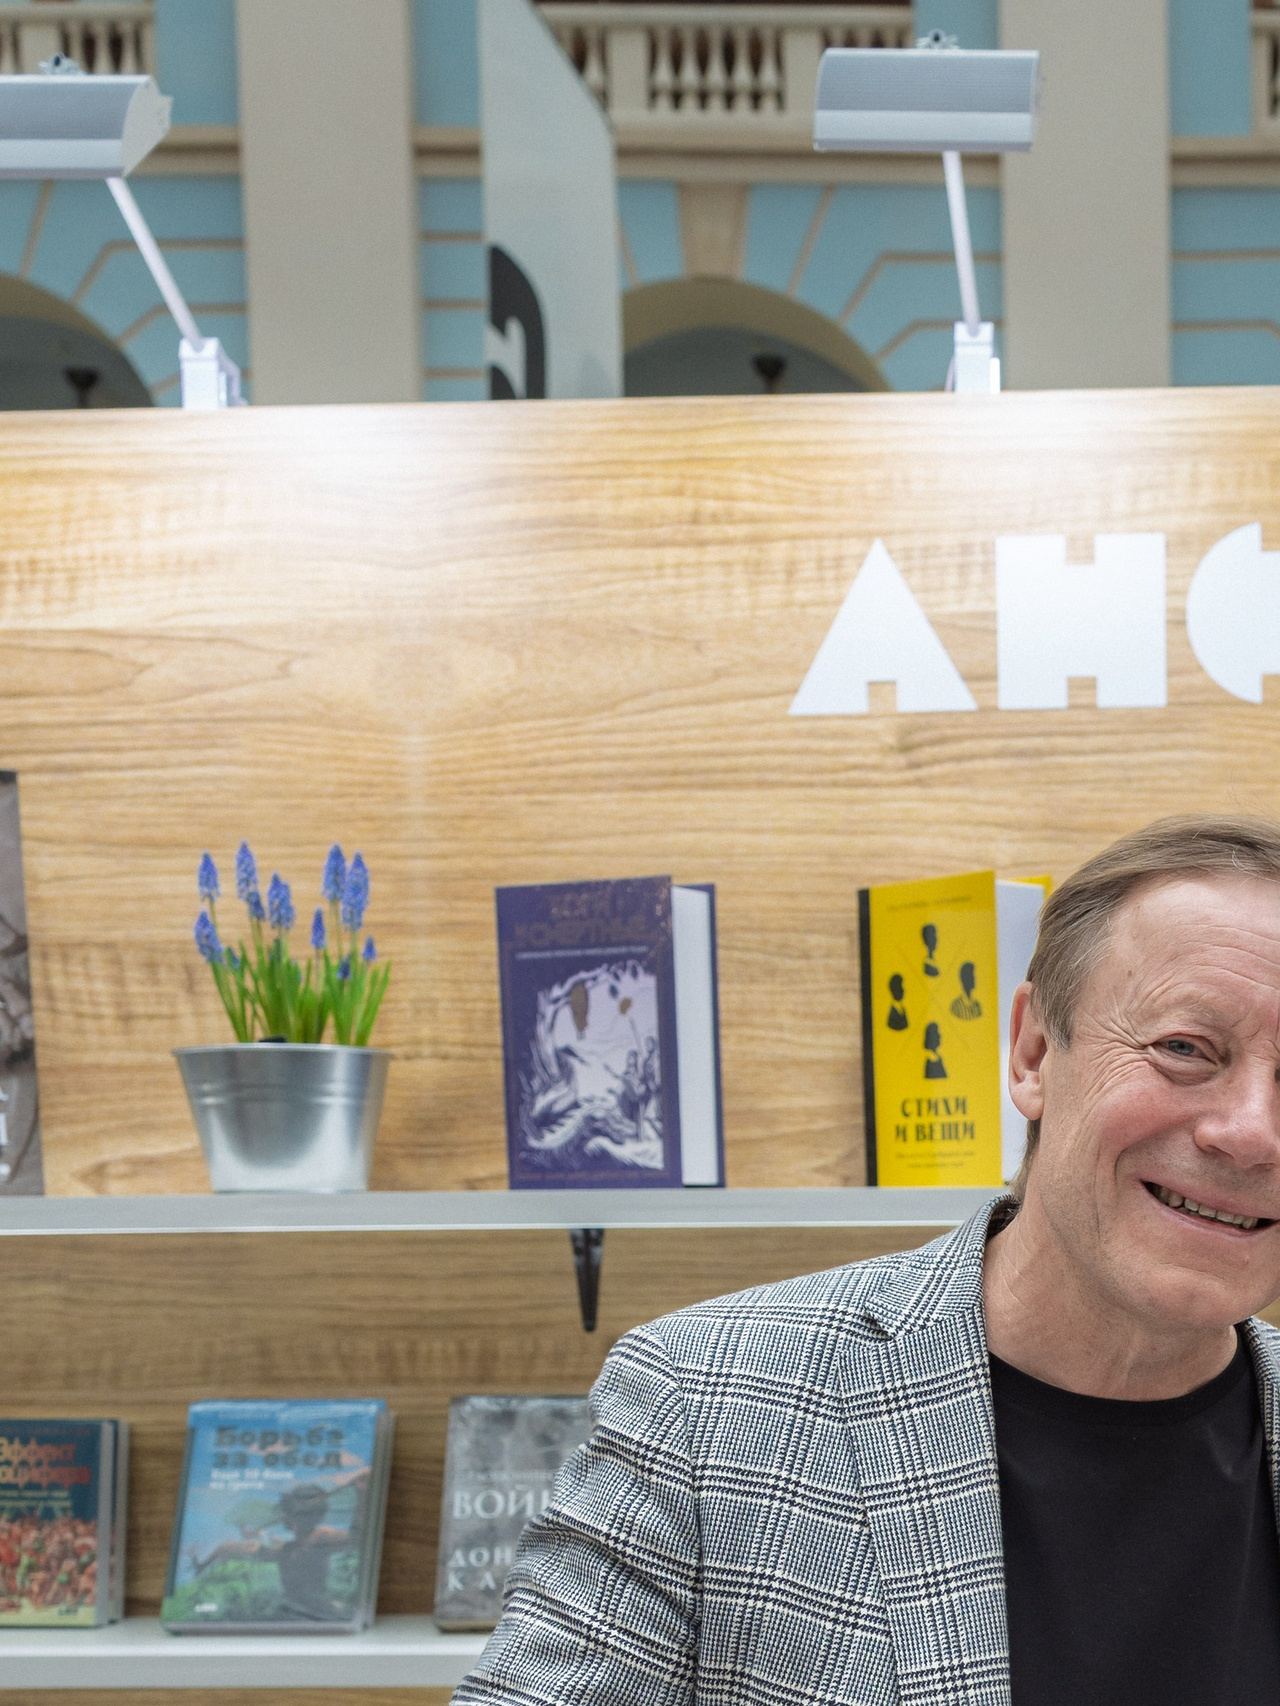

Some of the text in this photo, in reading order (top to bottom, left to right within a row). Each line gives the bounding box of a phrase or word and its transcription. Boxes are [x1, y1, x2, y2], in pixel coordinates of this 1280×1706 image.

[901, 1096, 967, 1118] СТИХИ
[895, 1120, 976, 1143] И ВЕЩИ
